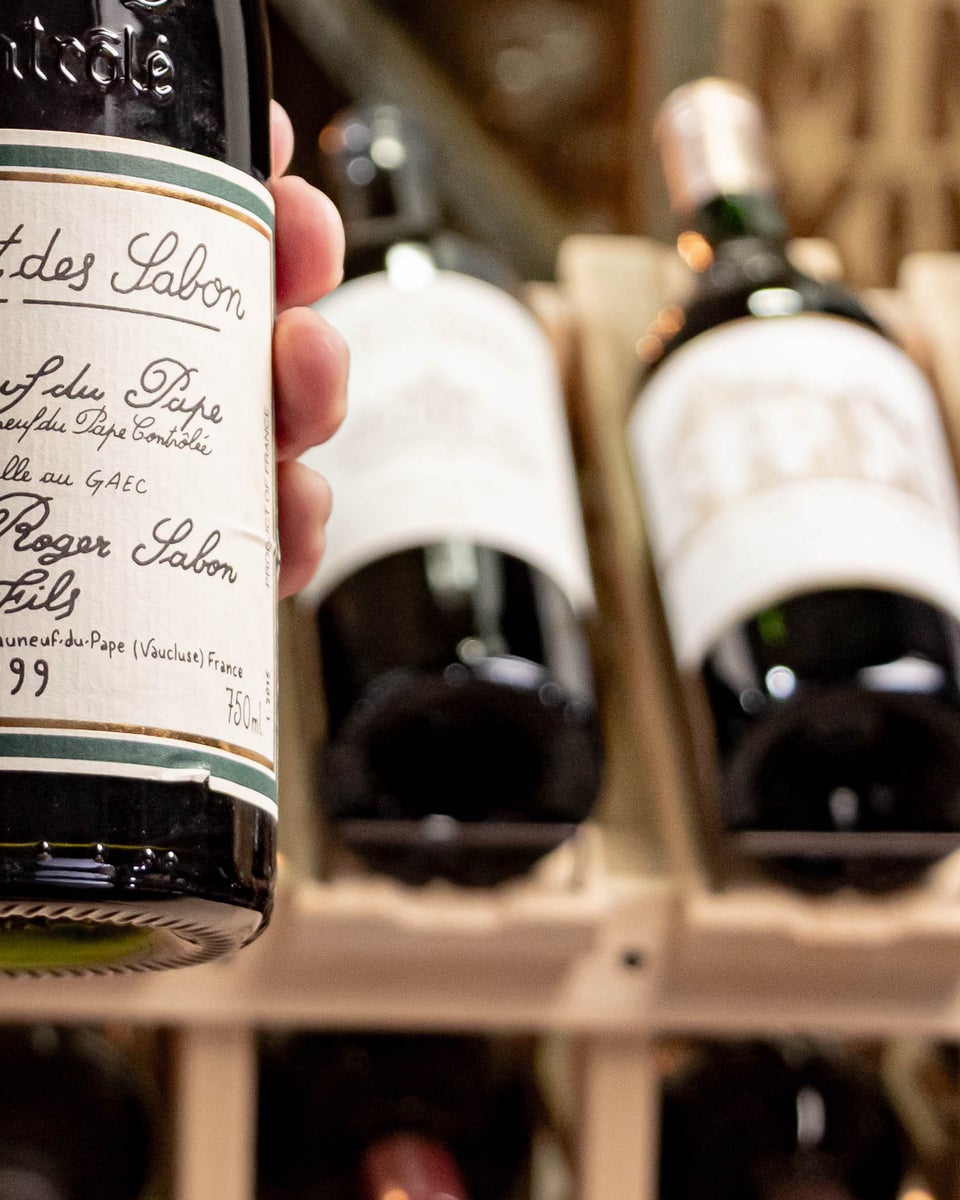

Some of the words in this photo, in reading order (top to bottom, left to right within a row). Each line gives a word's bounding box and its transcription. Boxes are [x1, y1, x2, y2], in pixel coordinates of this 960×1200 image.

[7, 228, 95, 291] des
[110, 230, 245, 320] Sabon
[41, 363, 105, 401] du
[124, 357, 223, 432] Pape
[33, 407, 68, 434] du
[72, 405, 128, 452] Pape
[132, 413, 213, 457] Contrôlée
[263, 406, 271, 475] FRANCE
[40, 471, 74, 486] au
[86, 469, 147, 496] GAEC
[132, 517, 237, 584] Sabon
[133, 638, 204, 669] (Vaucluse)
[208, 651, 243, 678] France
